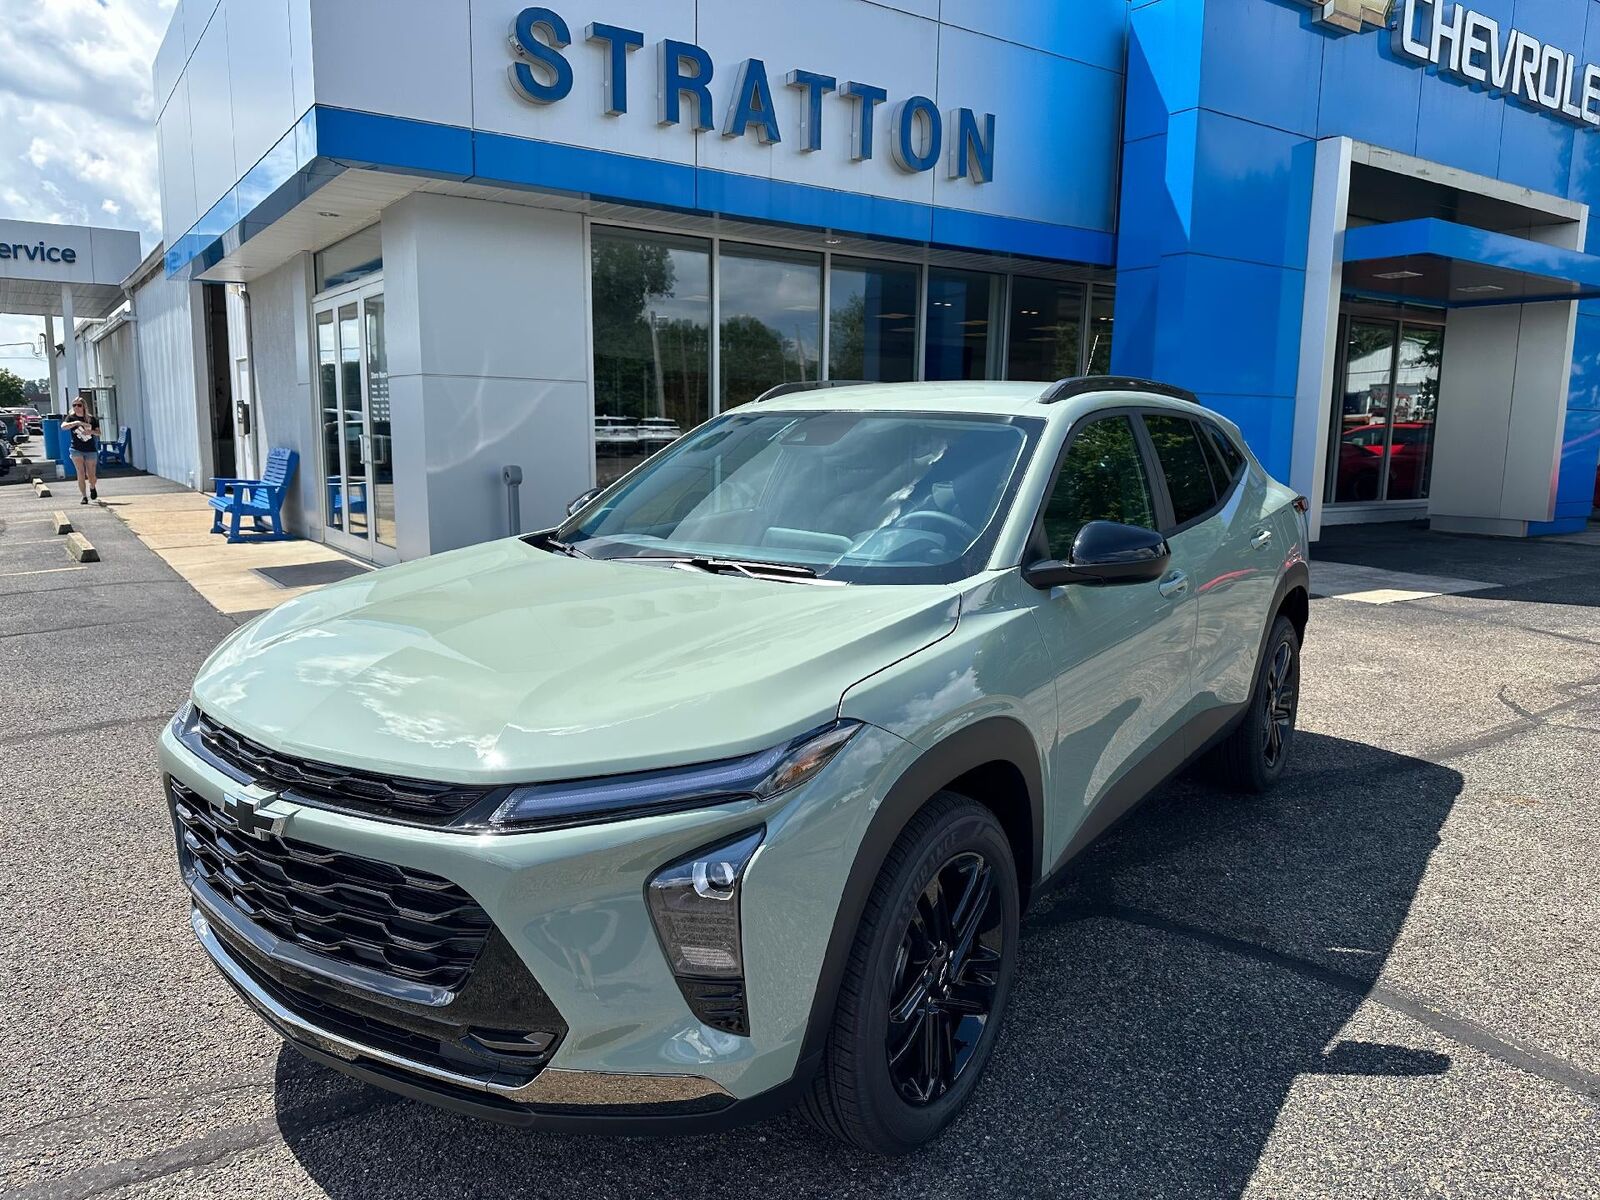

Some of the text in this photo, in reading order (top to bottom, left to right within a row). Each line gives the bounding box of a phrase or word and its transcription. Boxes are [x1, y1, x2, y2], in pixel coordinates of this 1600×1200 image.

[508, 6, 996, 183] STRATTON
[1402, 0, 1600, 125] CHEVROLE
[0, 241, 76, 263] ervice
